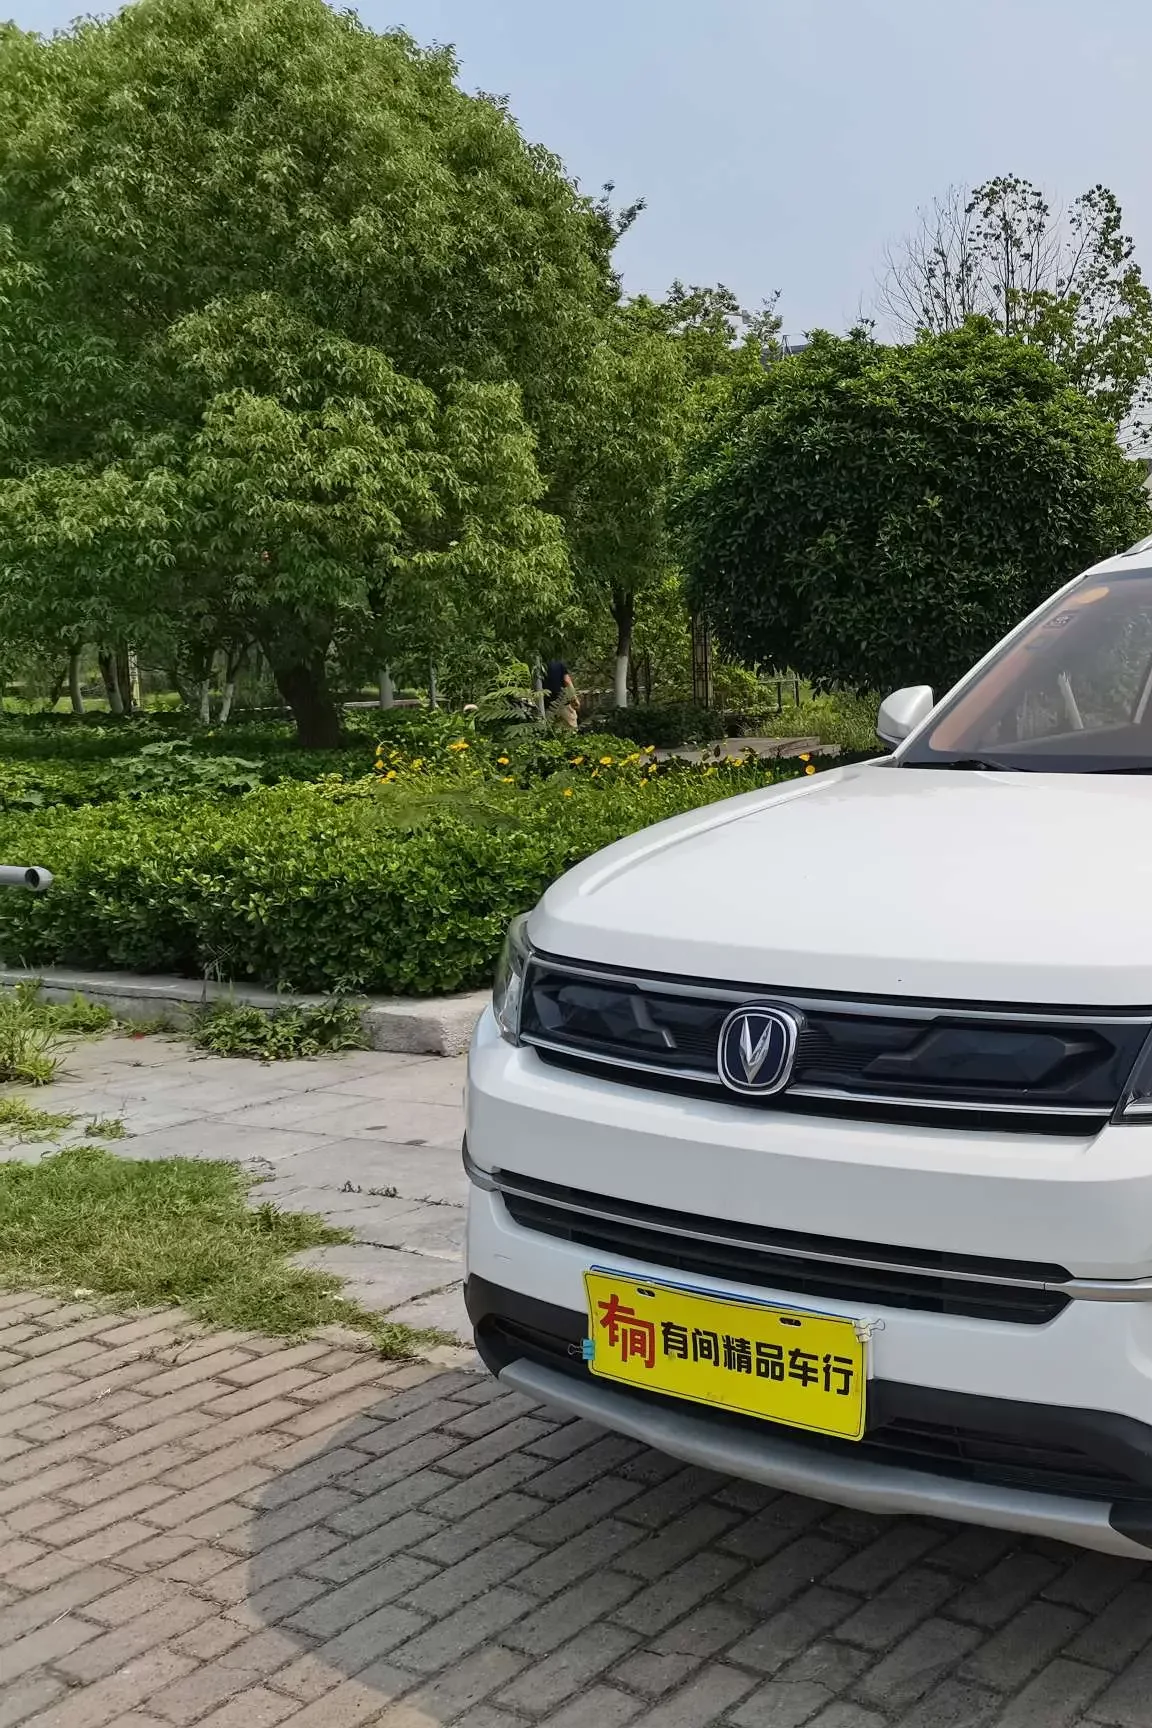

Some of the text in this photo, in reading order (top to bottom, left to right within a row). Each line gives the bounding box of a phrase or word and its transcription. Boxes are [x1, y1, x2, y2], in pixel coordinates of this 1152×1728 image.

[661, 1321, 854, 1396] 有间精品车行
